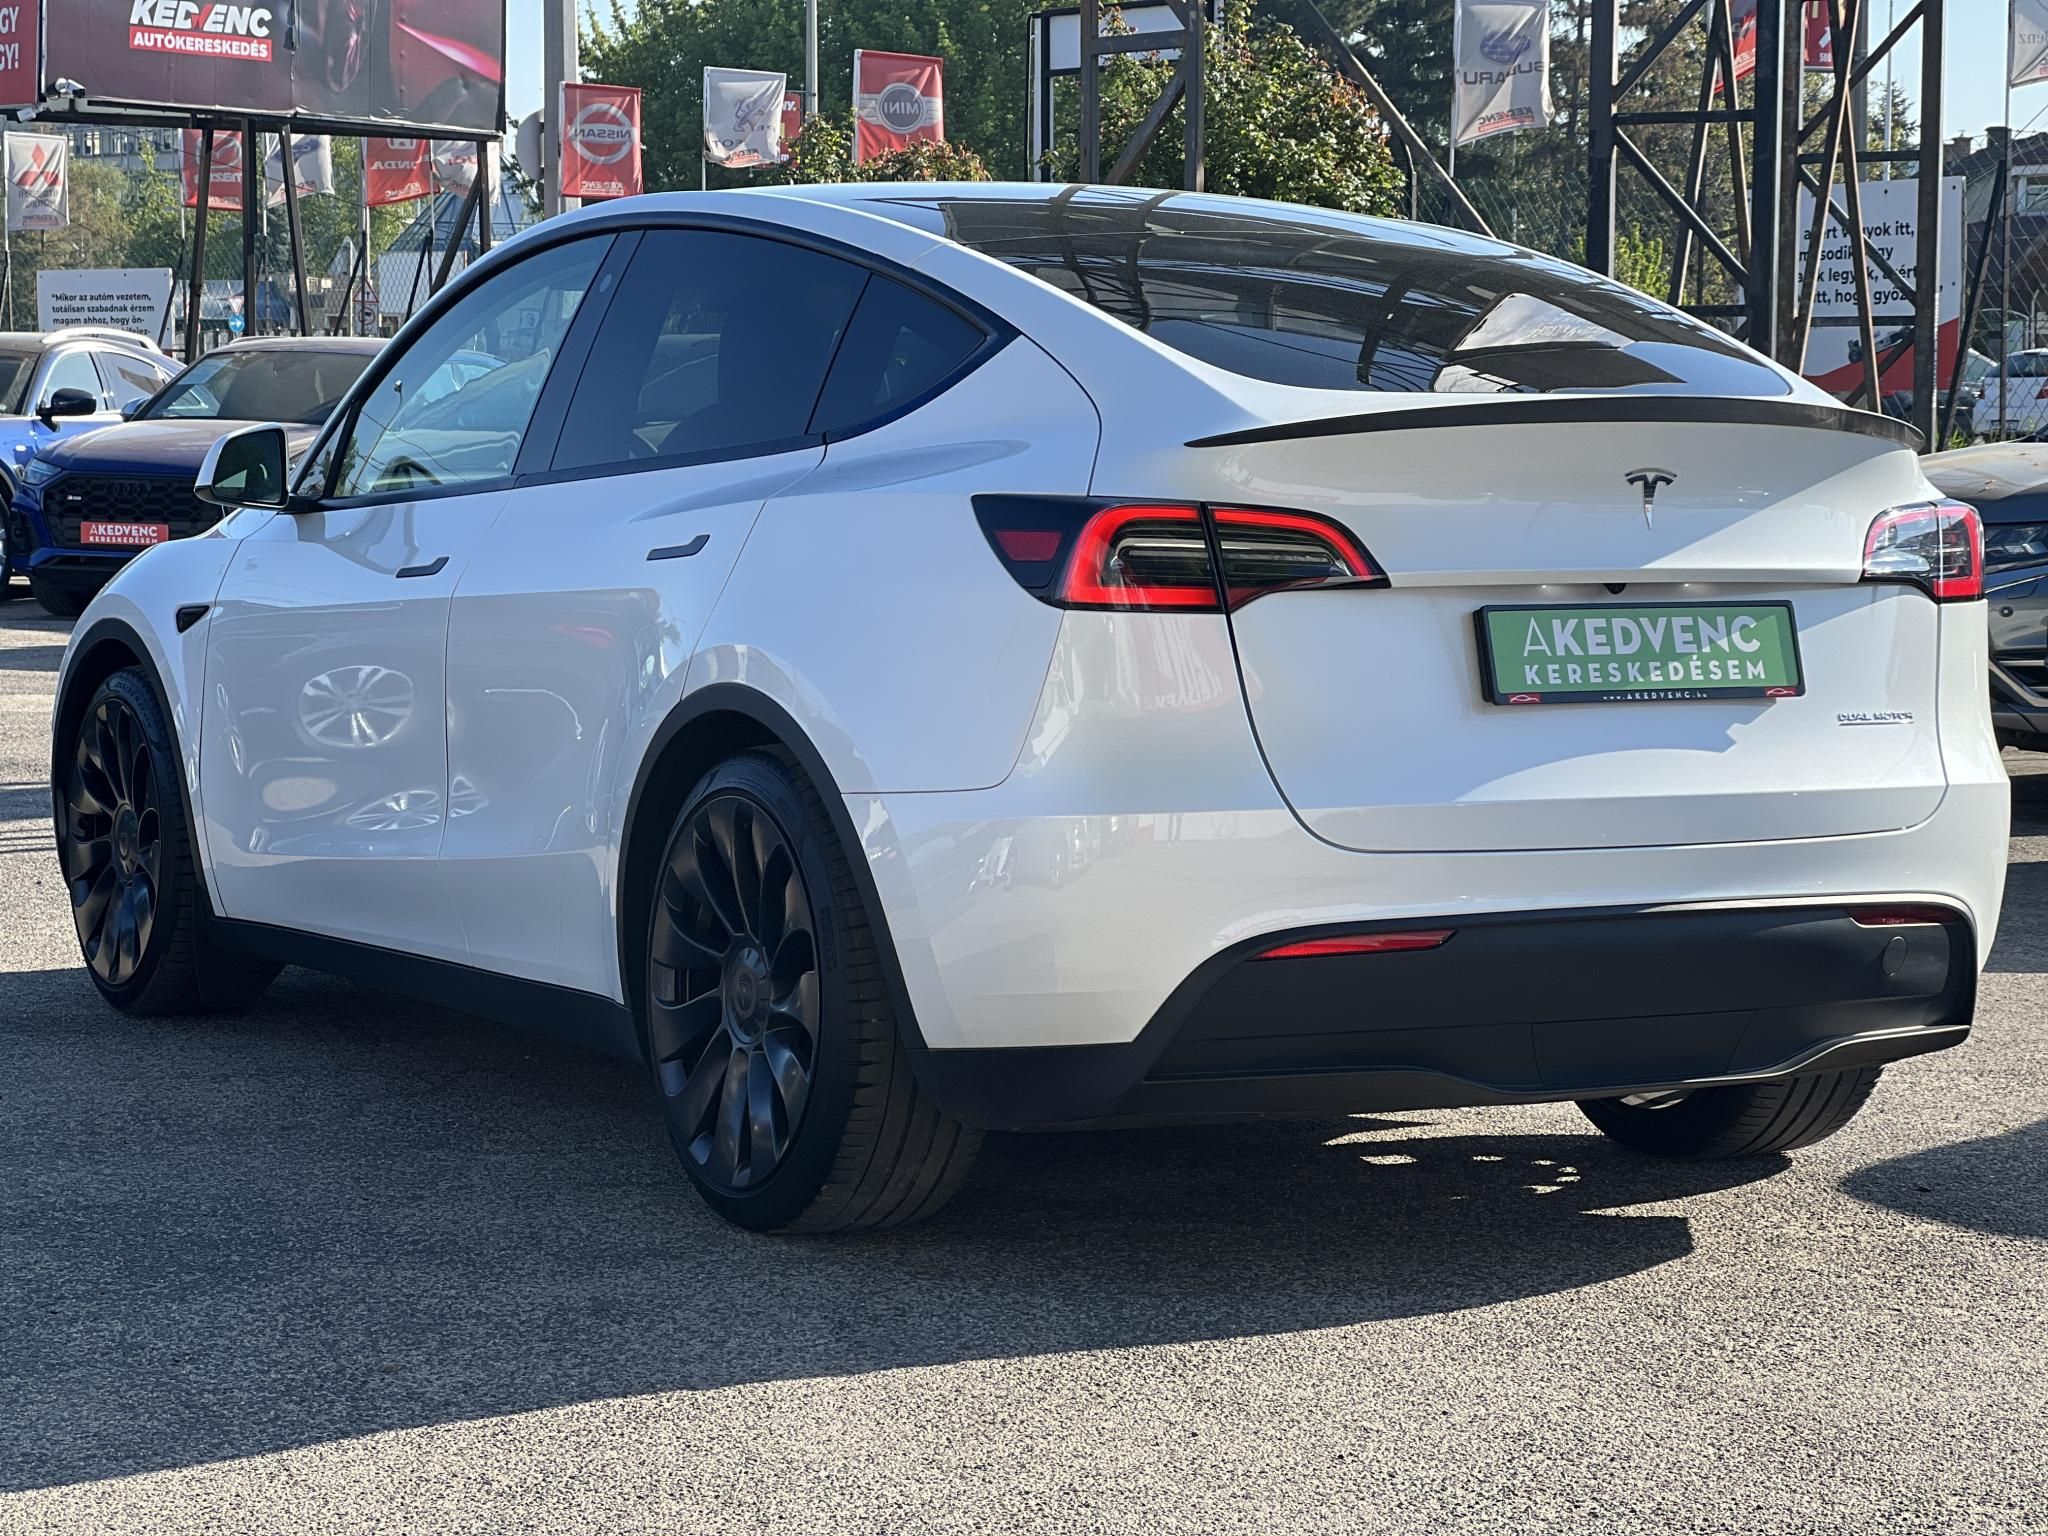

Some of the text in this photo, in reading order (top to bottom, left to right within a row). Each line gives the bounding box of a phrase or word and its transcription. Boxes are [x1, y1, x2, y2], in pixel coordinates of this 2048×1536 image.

[130, 0, 273, 38] KEDVENC
[133, 32, 268, 58] AUTÓKERESKEDÉS
[1895, 220, 1915, 238] itt,
[89, 293, 114, 301] autóm
[116, 293, 152, 301] vezetem,
[52, 303, 155, 313] totálisan szabadnak érzem
[53, 317, 82, 326] magam
[83, 316, 109, 325] ahhoz,
[110, 316, 130, 326] hogy
[89, 523, 158, 537] AKEDVENC
[1523, 615, 1761, 657] AKEDVENC
[1525, 655, 1766, 685] KERESKEDÉSEM
[1837, 712, 1913, 722] DUAL MOTOR
